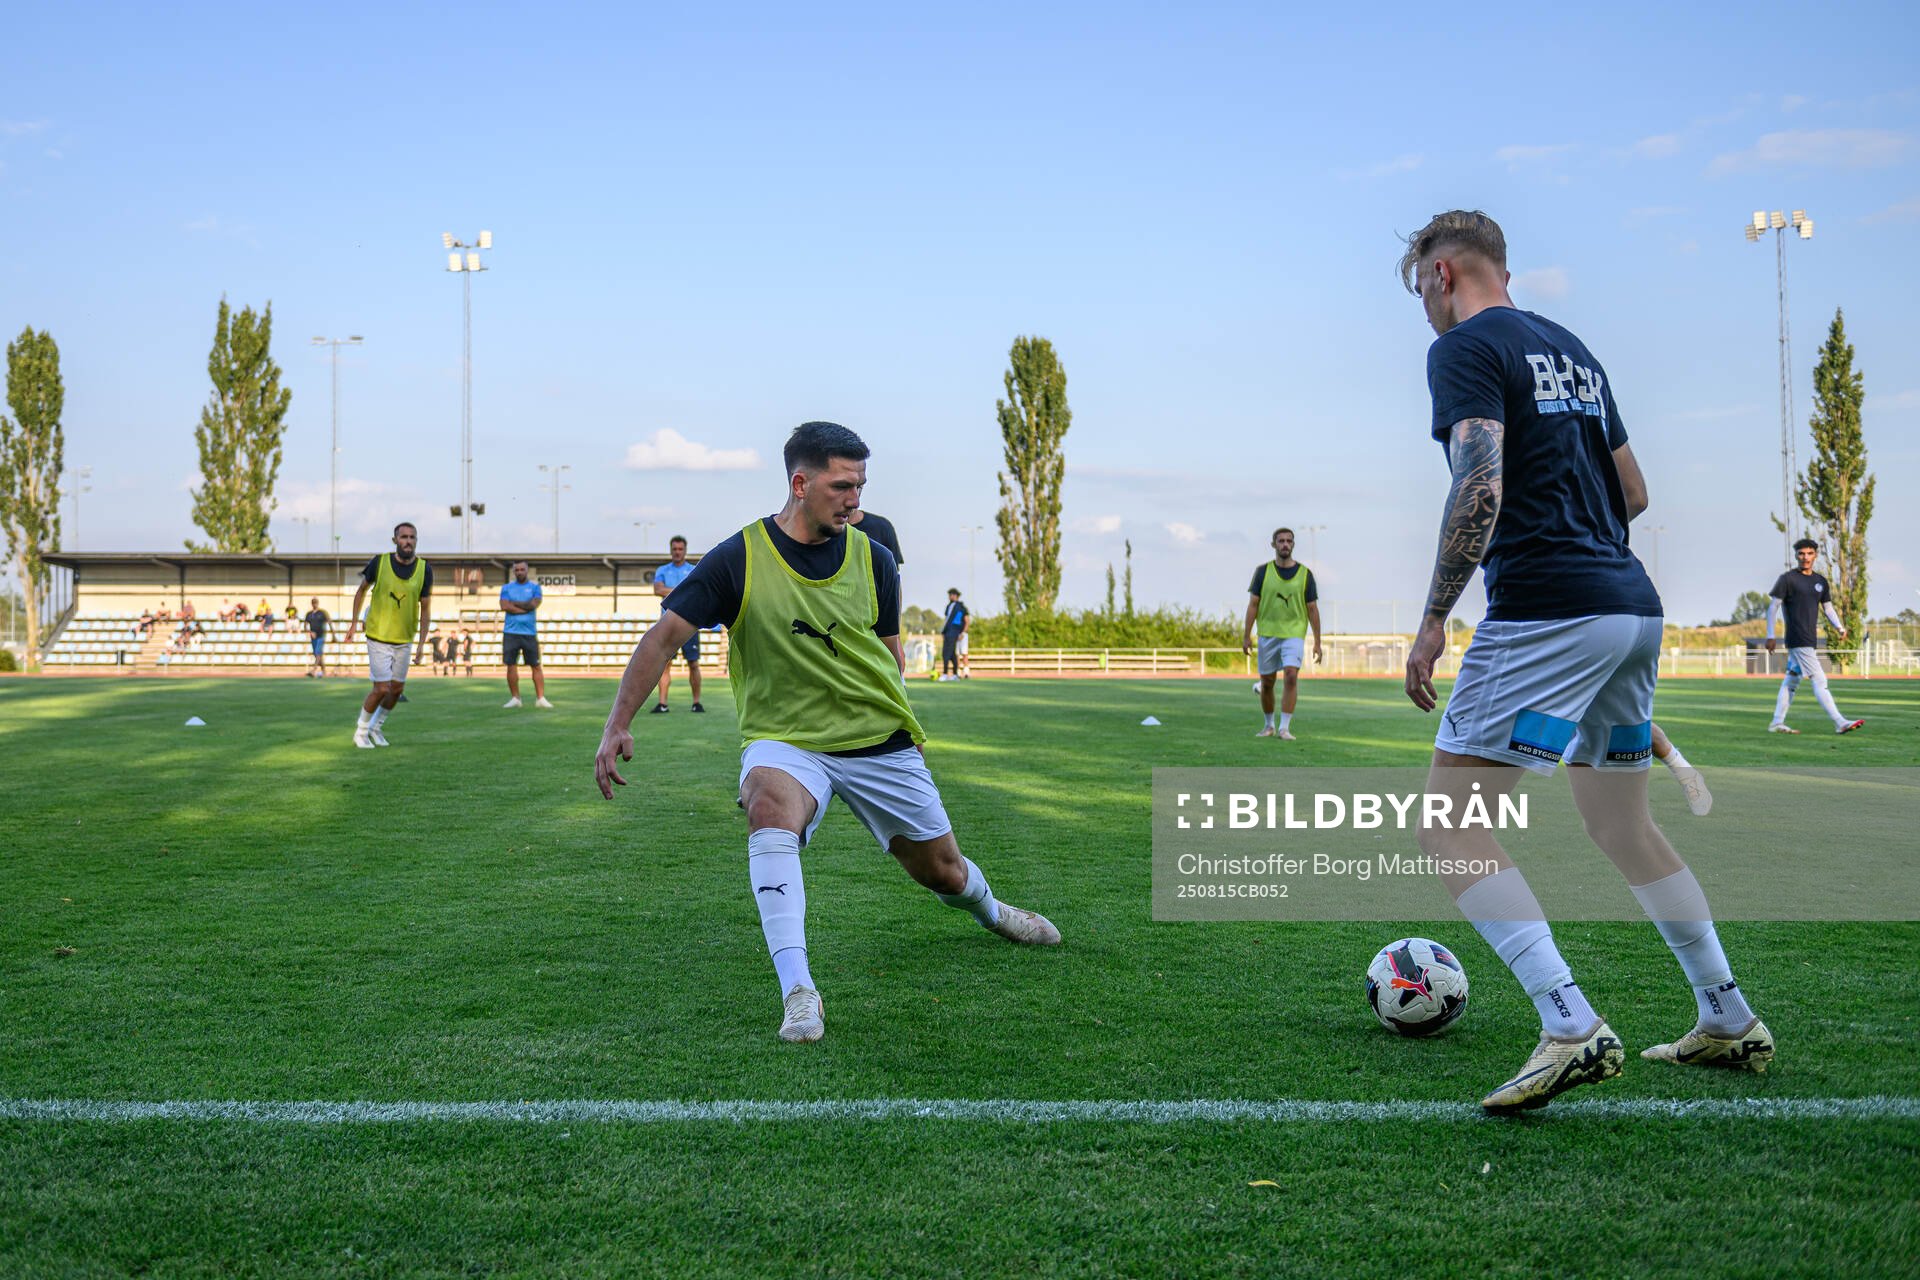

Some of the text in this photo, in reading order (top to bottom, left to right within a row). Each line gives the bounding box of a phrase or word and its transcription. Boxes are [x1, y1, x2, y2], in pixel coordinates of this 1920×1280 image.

[537, 574, 574, 587] sport
[1517, 744, 1532, 754] 040
[1549, 989, 1572, 1018] SOCKS
